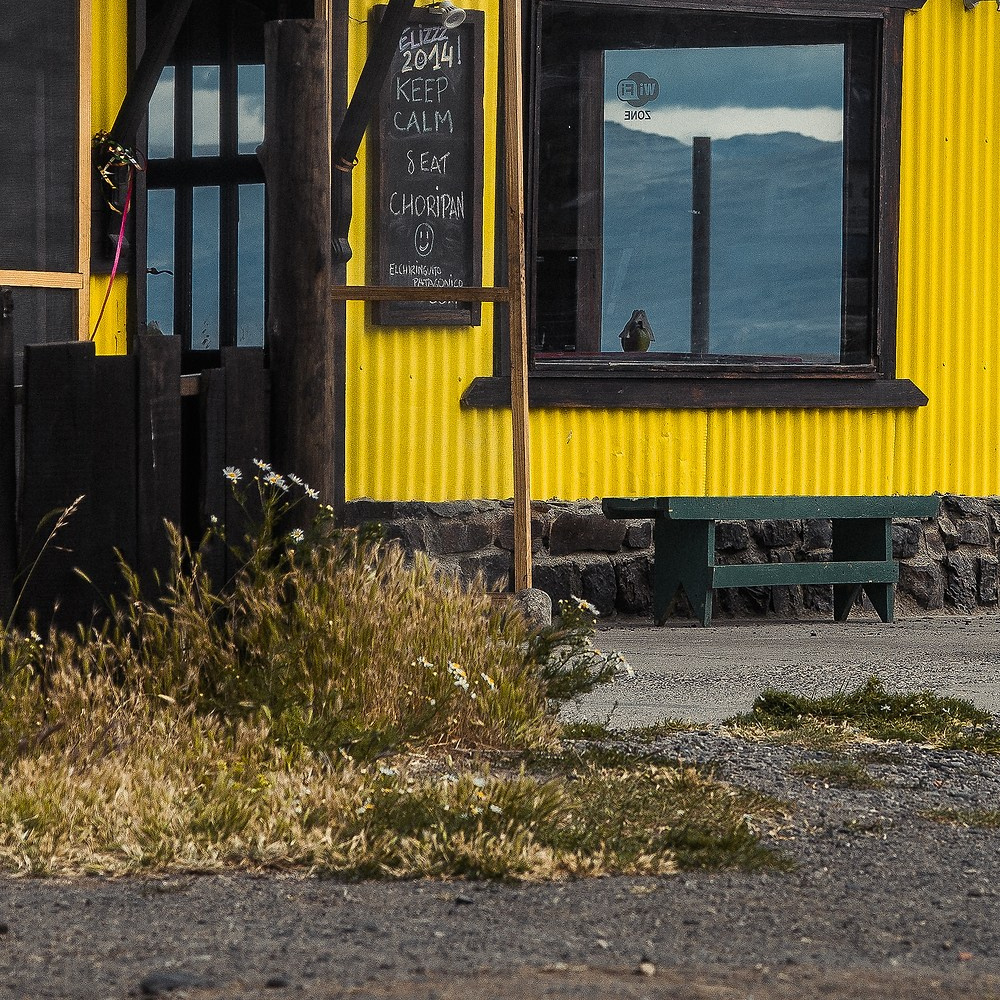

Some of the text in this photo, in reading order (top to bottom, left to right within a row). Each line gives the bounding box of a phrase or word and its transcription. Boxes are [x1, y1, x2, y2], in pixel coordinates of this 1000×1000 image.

[396, 76, 449, 103] KEEP
[393, 110, 453, 134] CALM
[389, 185, 465, 220] CHORIPAN
